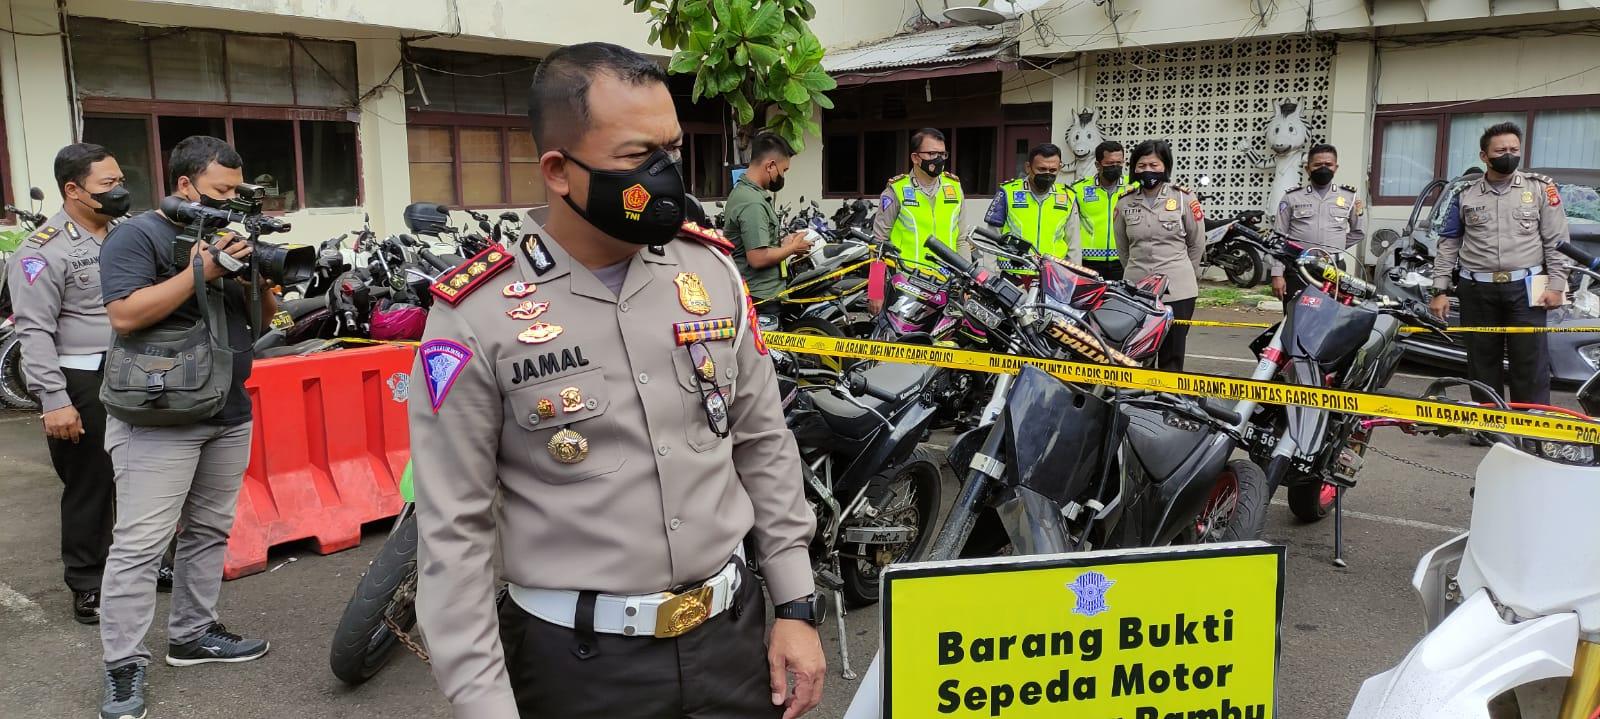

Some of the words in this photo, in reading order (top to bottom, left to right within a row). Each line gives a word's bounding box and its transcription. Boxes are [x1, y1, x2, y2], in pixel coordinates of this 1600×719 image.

[625, 211, 640, 221] TNI
[870, 344, 905, 359] MELINTAS
[511, 346, 589, 384] JAMAL
[989, 356, 1028, 369] DILARAN
[1177, 377, 1226, 395] DILARANG
[1229, 383, 1282, 402] MELINTAS
[1285, 389, 1319, 407] GARIS
[1321, 393, 1359, 411] POLISI
[1415, 404, 1478, 422] DILARANG
[1245, 427, 1254, 440] R
[938, 626, 1103, 666] Barang
[1119, 609, 1234, 650] Bukti
[937, 669, 1097, 717] Sepeda
[1111, 663, 1234, 697] Motor
